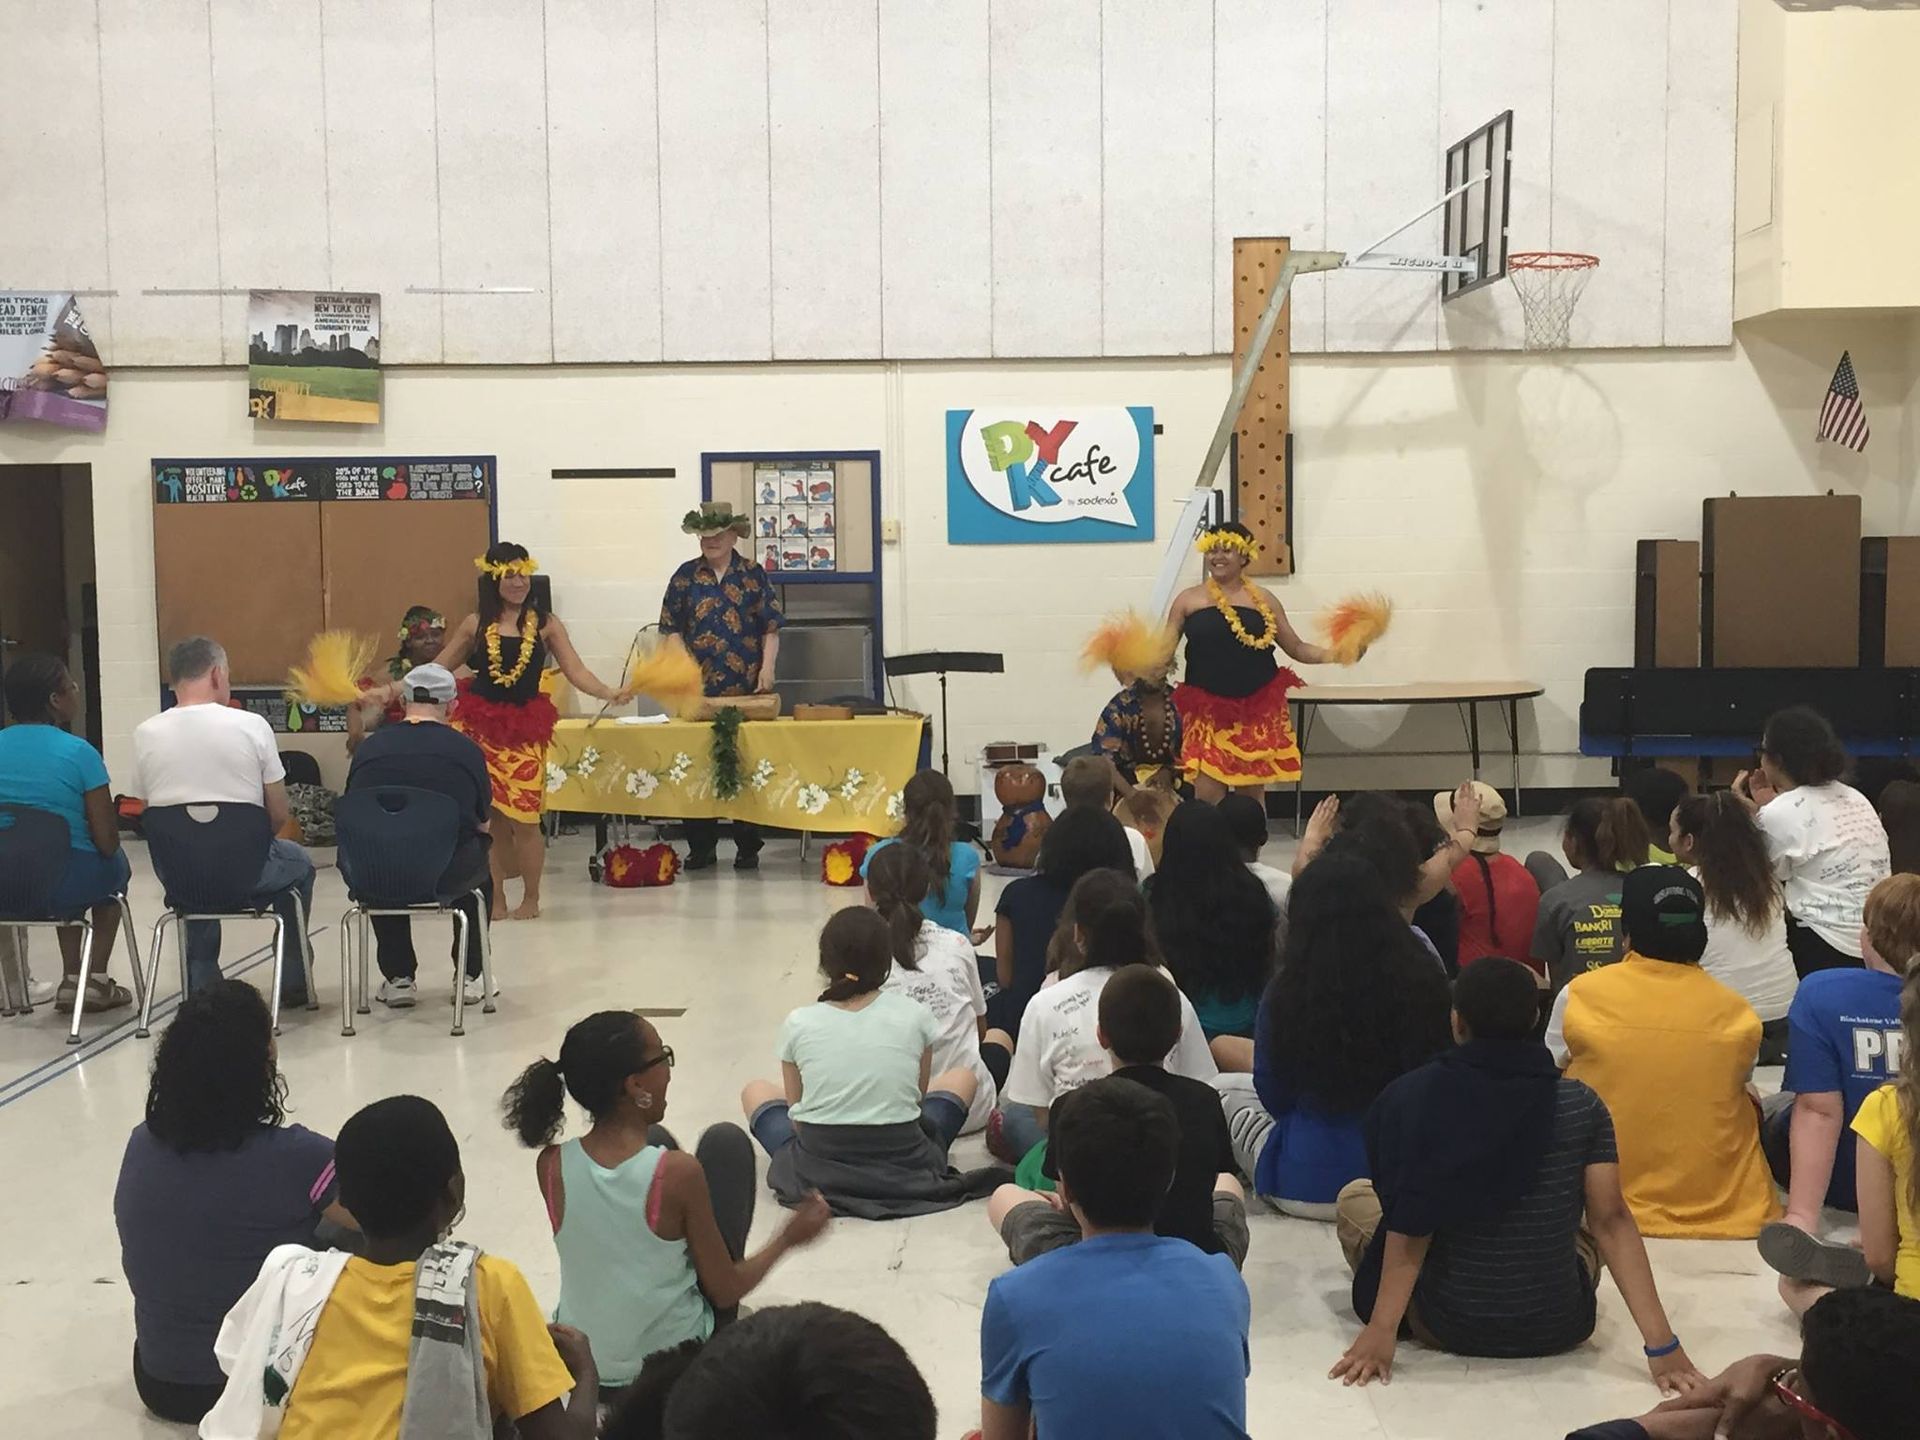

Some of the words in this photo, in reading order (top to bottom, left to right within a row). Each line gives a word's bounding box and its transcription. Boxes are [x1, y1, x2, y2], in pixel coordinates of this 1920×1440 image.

[314, 296, 344, 304] CENTRAL
[314, 304, 329, 313] NEW
[332, 304, 352, 313] YORK
[355, 304, 370, 314] CITY
[1050, 444, 1117, 486] cafe
[351, 466, 362, 475] OF
[363, 467, 378, 475] THE
[186, 483, 227, 494] POSITIVE
[336, 488, 352, 496] THE
[355, 488, 380, 496] BRAIN
[1076, 494, 1118, 506] sodexo
